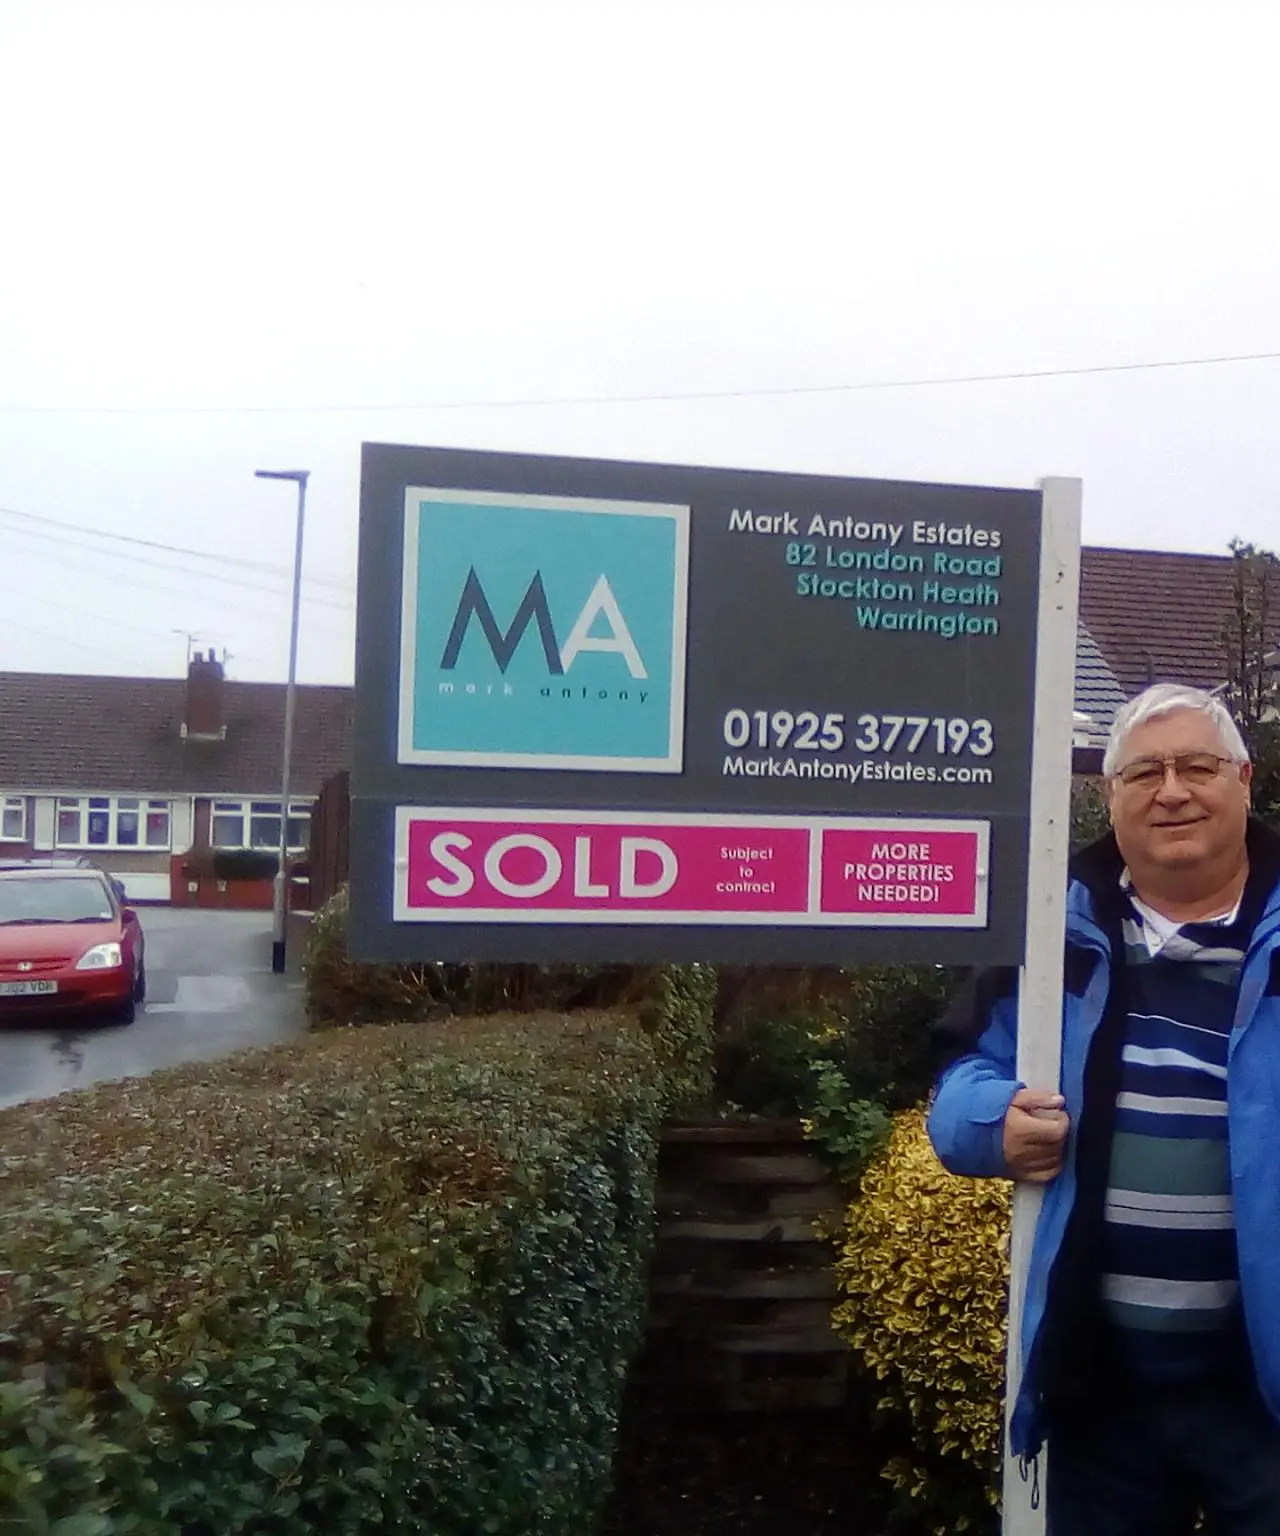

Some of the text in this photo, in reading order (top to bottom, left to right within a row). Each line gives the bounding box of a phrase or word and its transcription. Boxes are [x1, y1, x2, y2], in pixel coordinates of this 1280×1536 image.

[728, 508, 1001, 547] Mark Antony Estates
[785, 543, 1000, 577] 82 London Road
[797, 573, 999, 606] Stockton Heath
[439, 564, 649, 679] MA
[856, 607, 998, 637] Warrington
[438, 682, 649, 703] mark antony
[723, 708, 994, 756] 01925 377193
[722, 756, 993, 784] MarkAntonyEstates.com
[426, 831, 678, 899] SOLD
[720, 847, 773, 862] Subject
[871, 843, 930, 860] MORE
[739, 865, 754, 878] to
[844, 864, 954, 882] PROPERTIES
[716, 881, 776, 893] contract
[858, 885, 939, 902] NEEDED!
